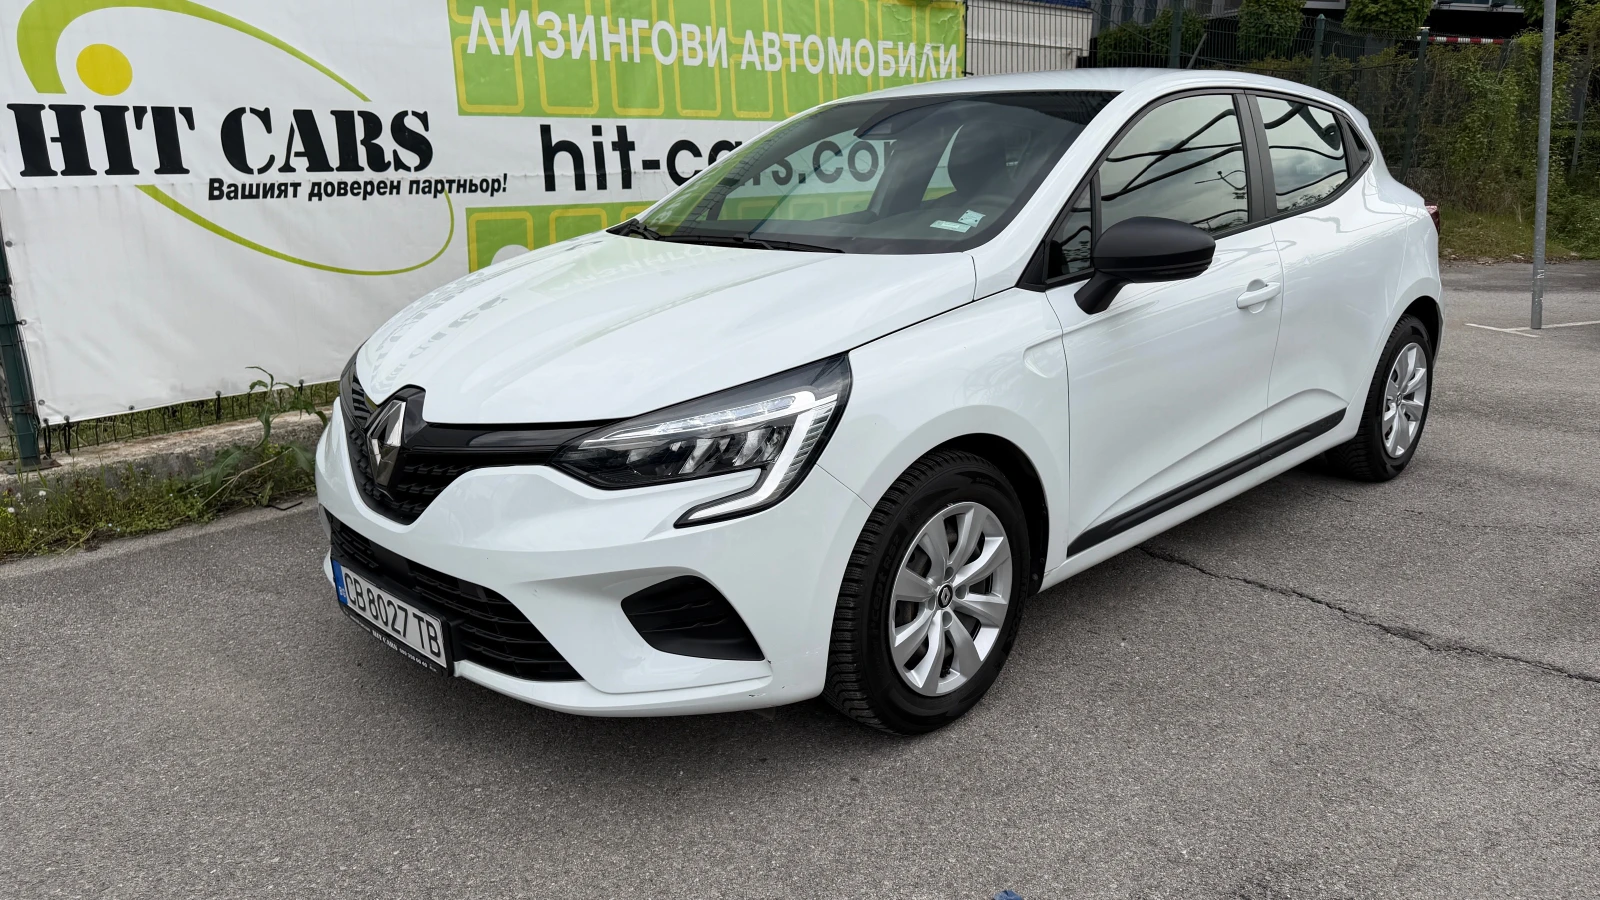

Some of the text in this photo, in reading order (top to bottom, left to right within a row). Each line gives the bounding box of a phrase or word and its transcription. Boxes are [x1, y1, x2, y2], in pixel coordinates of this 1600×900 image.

[467, 5, 957, 78] ЛИЗИНГОВИ АВТОМОБИЛИ
[7, 103, 434, 177] HIT CARS
[540, 124, 898, 192] hit-cas.co
[208, 173, 508, 201] Вашият доверен партньор!
[366, 587, 408, 639] 8027
[412, 611, 441, 659] TB
